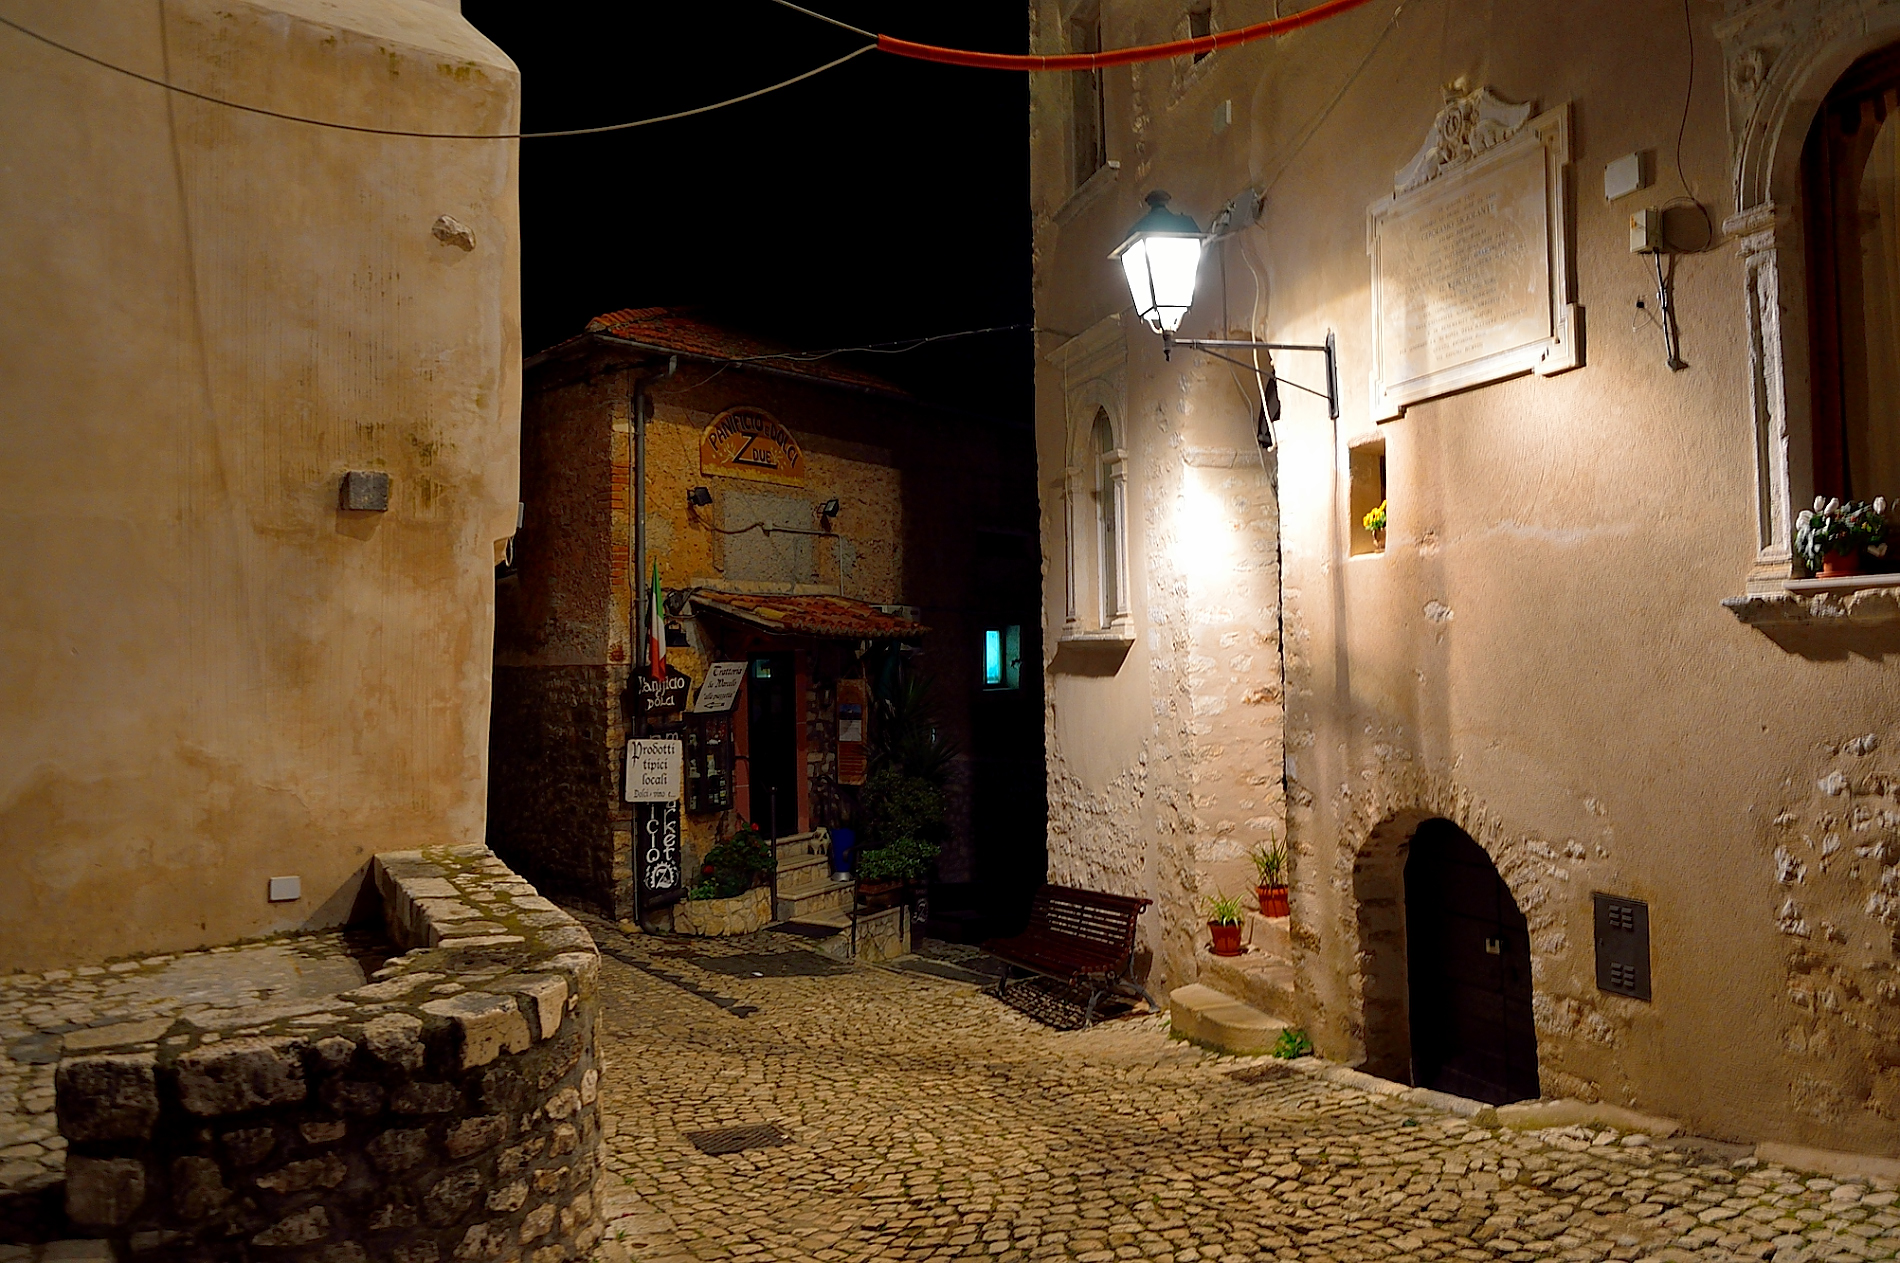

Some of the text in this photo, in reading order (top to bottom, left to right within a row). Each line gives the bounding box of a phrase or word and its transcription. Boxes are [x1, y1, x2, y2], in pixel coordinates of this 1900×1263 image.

[709, 413, 763, 452] PANIFICIO
[769, 422, 799, 469] DOLCI
[752, 448, 772, 464] DUE
[631, 741, 676, 769] Prodotti
[643, 758, 668, 773] tipici
[642, 773, 668, 785] locali
